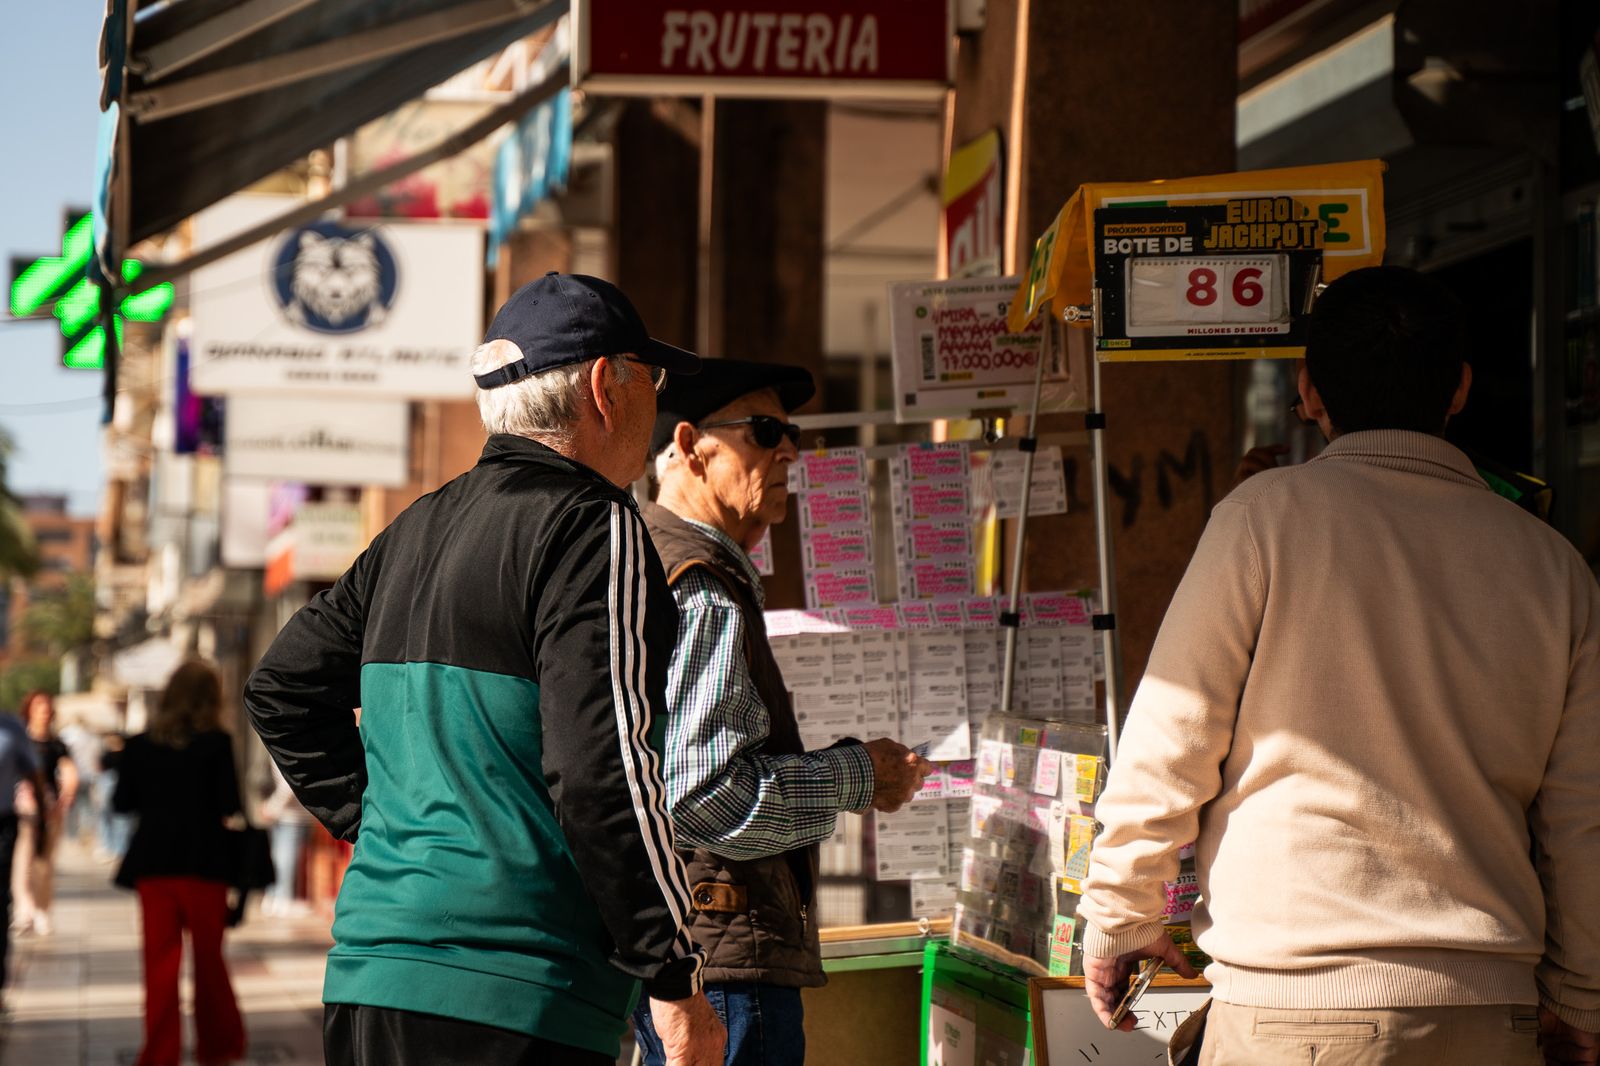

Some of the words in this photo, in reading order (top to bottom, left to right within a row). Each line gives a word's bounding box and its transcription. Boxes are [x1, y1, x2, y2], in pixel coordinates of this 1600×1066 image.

[661, 11, 878, 73] FRUTERIA
[1227, 199, 1291, 223] EURO
[1107, 225, 1147, 234] PRÓXIMO
[1149, 225, 1184, 233] SORTEO
[1203, 221, 1316, 249] JACKPOT
[1103, 238, 1160, 254] BOTE
[1165, 237, 1193, 252] DE
[1131, 1010, 1199, 1030] EXT
